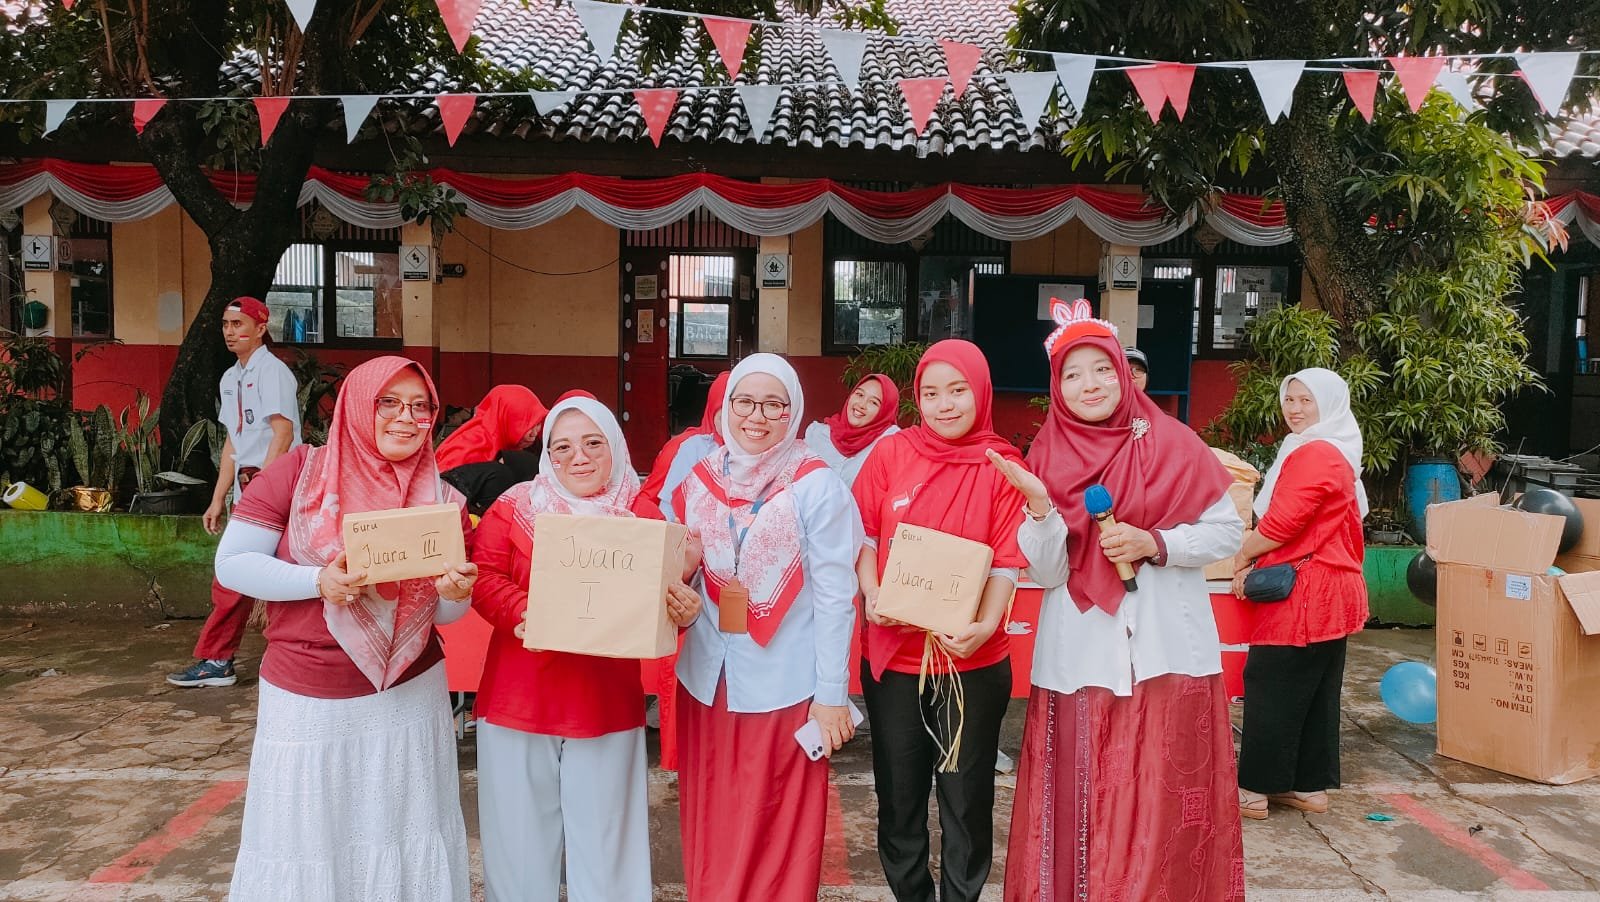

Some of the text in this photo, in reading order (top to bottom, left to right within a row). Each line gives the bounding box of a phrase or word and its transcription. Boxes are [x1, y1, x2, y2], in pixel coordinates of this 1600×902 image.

[352, 521, 378, 533] Guru
[901, 528, 923, 542] Guru
[361, 531, 442, 569] Juara III
[559, 535, 635, 572] Juara
[891, 560, 967, 602] Juara II
[577, 581, 601, 620] I
[1451, 649, 1464, 658] CM
[1452, 659, 1470, 669] KGS
[1504, 659, 1534, 671] MEAS:
[1452, 669, 1470, 680] KGS
[1454, 680, 1533, 704] QTY: PCS
[1511, 704, 1533, 714] ITEM
